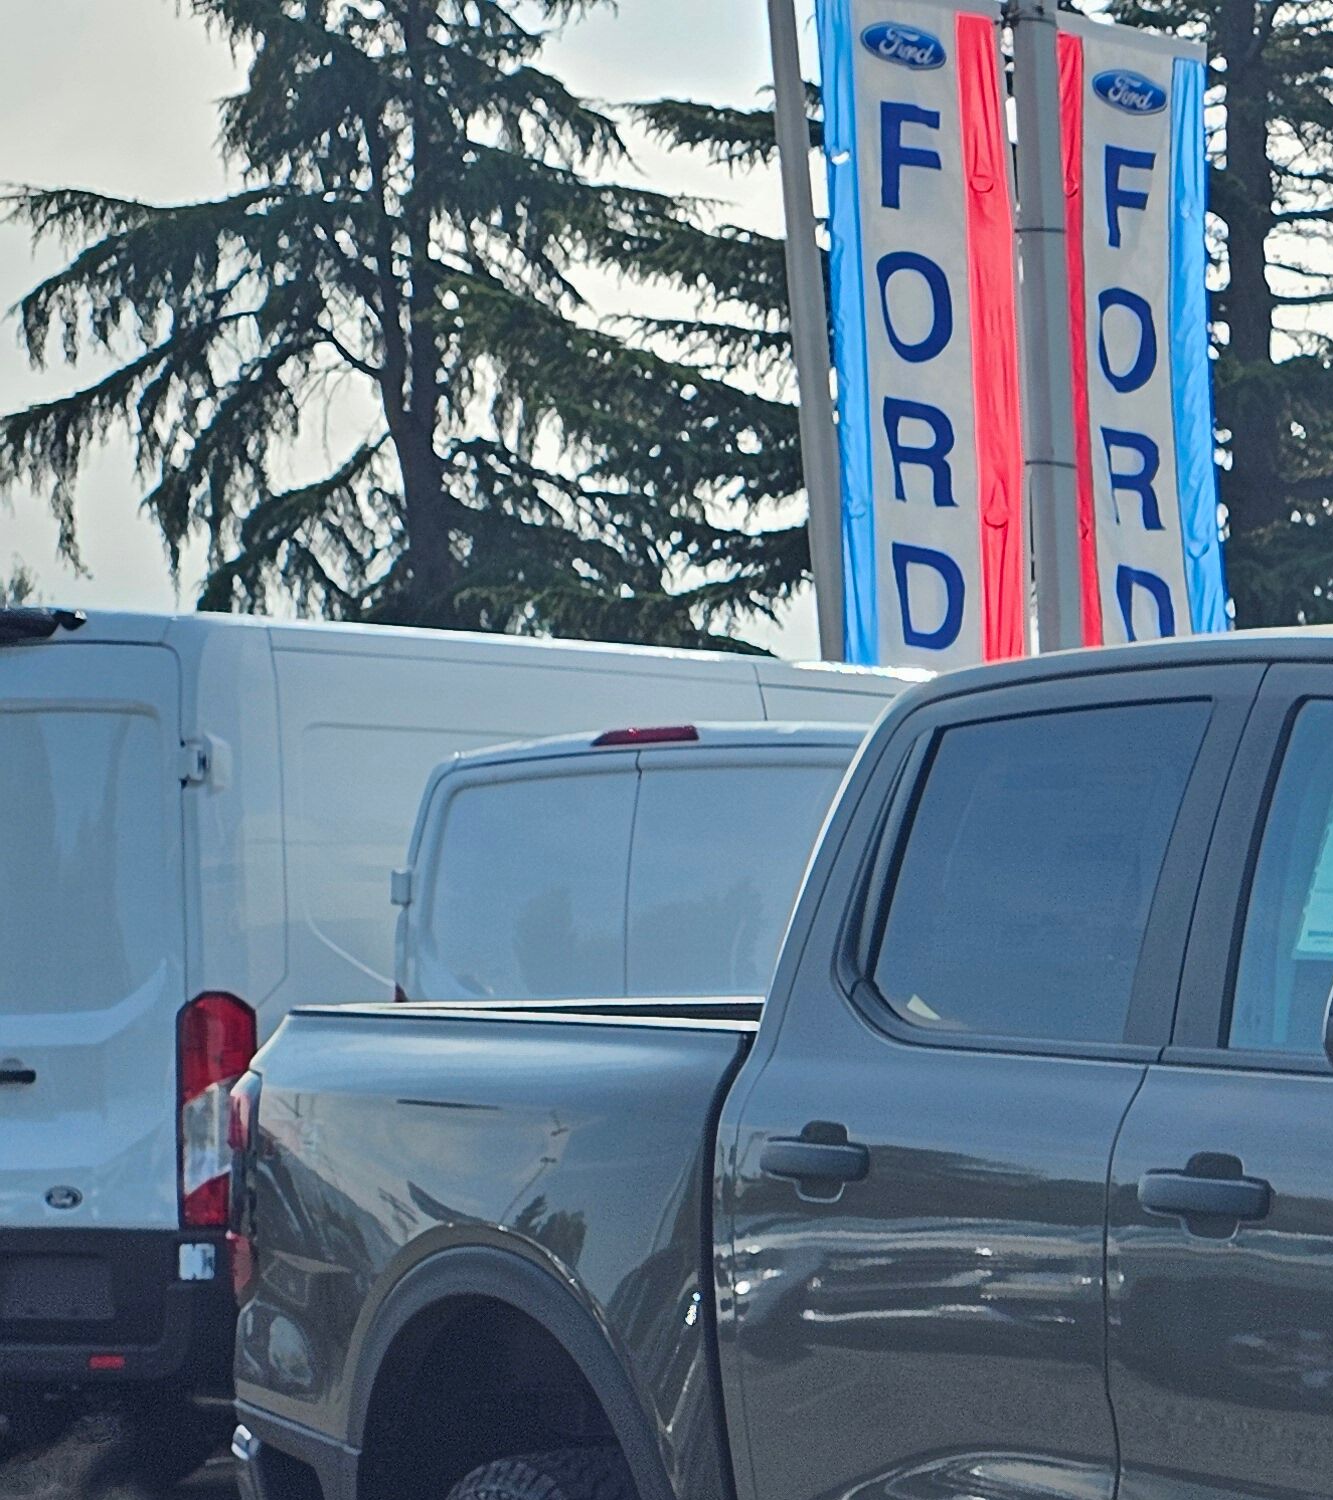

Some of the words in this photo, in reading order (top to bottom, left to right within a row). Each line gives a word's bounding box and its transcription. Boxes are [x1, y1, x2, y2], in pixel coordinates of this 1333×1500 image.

[878, 26, 936, 66] Ford
[1106, 77, 1153, 111] Ford
[876, 100, 965, 650] FORD
